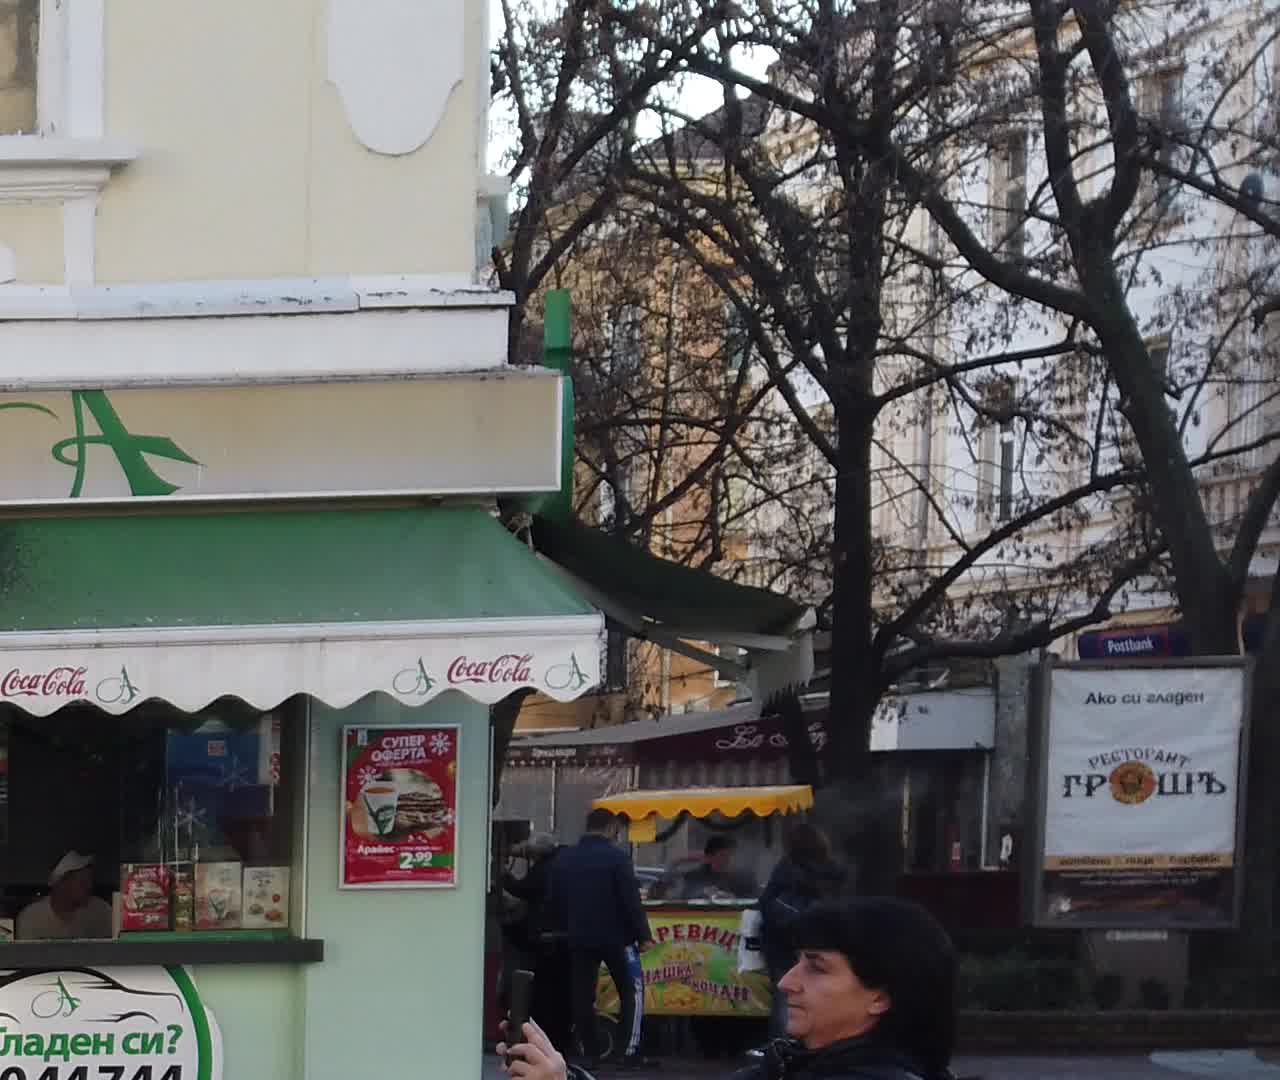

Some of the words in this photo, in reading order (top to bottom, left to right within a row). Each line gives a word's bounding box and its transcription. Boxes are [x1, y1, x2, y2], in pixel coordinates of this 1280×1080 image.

[1106, 637, 1154, 653] Postbank
[446, 655, 535, 685] Coca-Cola
[0, 667, 88, 697] Coca-Cola
[1084, 692, 1117, 705] Ако
[381, 735, 426, 748] СУПЕР
[371, 749, 426, 762] ОФЕРТА
[1088, 749, 1189, 770] РЕСТОРАНТ
[122, 1025, 183, 1055] си?
